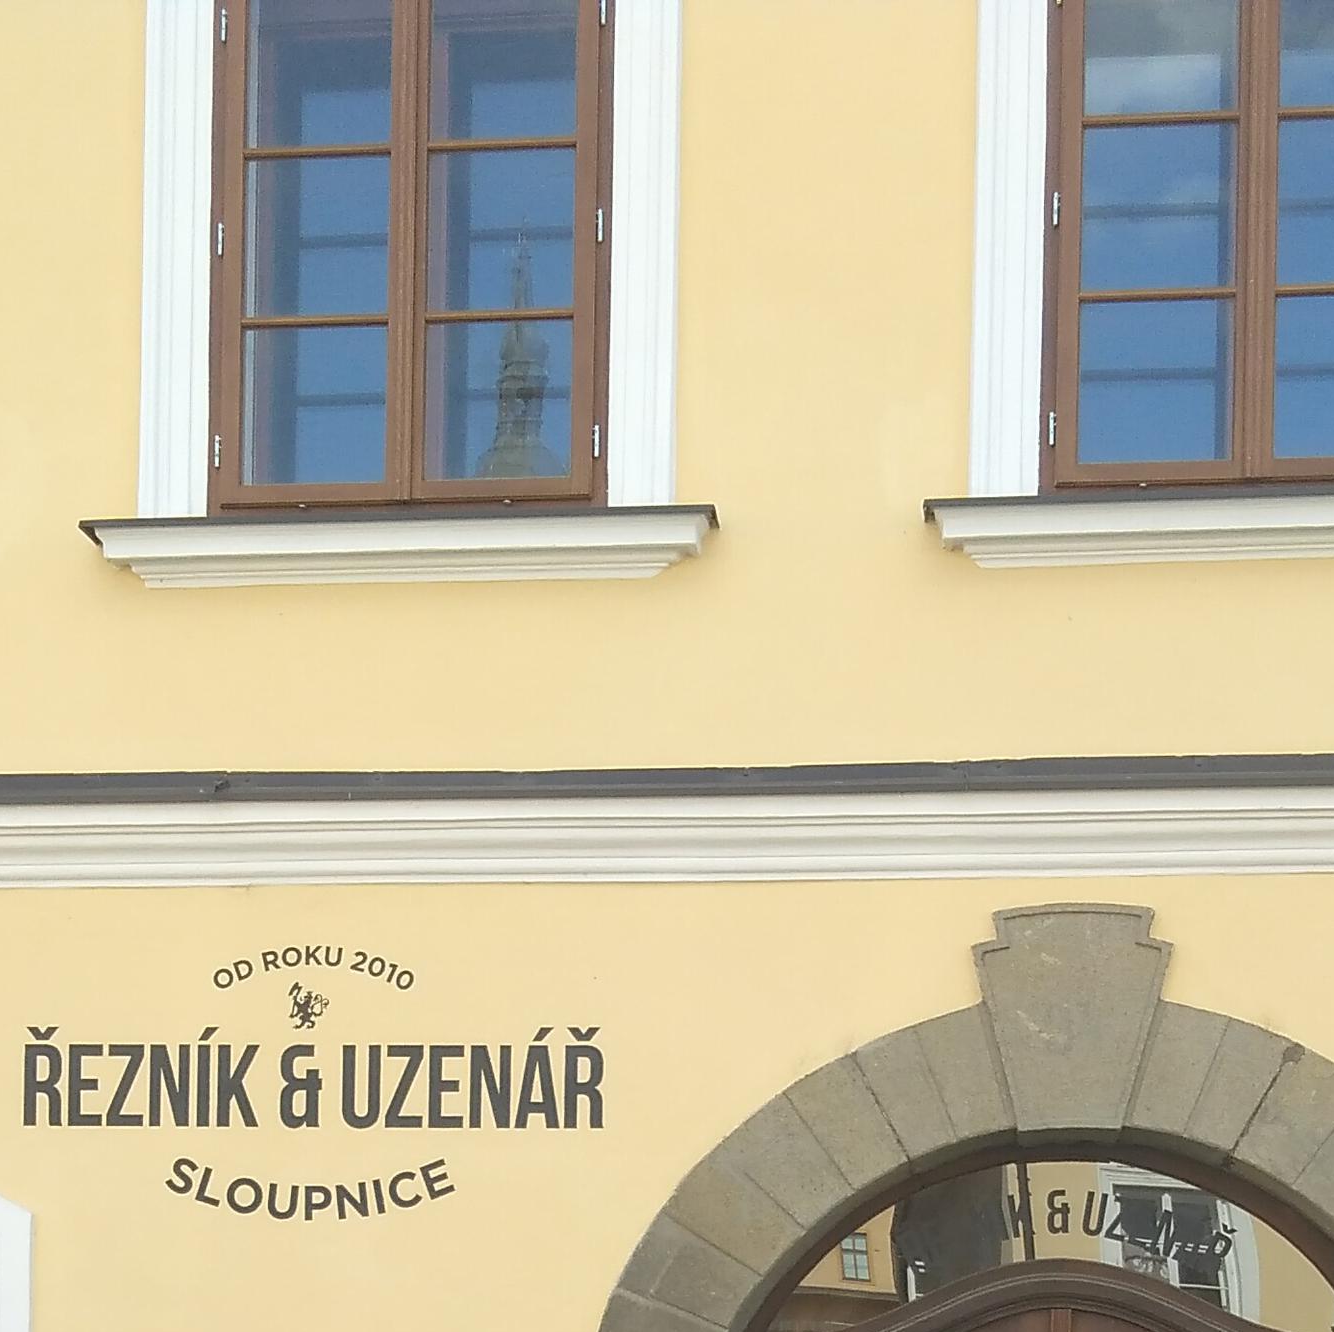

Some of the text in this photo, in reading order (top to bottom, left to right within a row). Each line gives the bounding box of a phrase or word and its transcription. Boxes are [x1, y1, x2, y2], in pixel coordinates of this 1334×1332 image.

[213, 945, 414, 990] OD ROKU 2010
[23, 1026, 605, 1129] ŘEZNÍK & UZENÁŘ
[165, 1158, 456, 1221] SLOUPNICE
[1047, 1190, 1070, 1234] &
